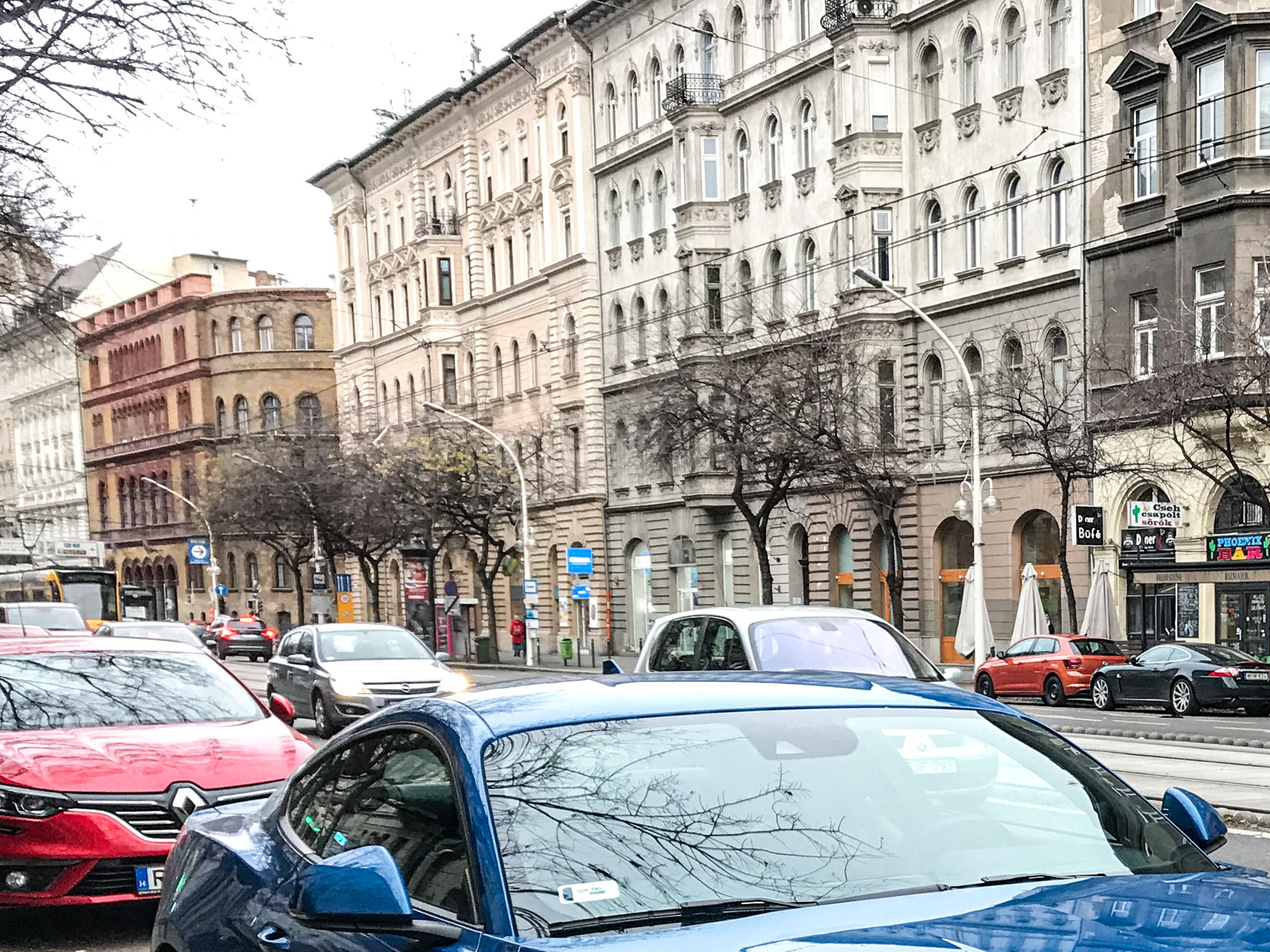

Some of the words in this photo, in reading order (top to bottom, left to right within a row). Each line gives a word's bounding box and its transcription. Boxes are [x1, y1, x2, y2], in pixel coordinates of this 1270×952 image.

[1141, 511, 1181, 519] csapolt
[1216, 535, 1263, 547] PHOENIX
[1217, 546, 1263, 560] BAR
